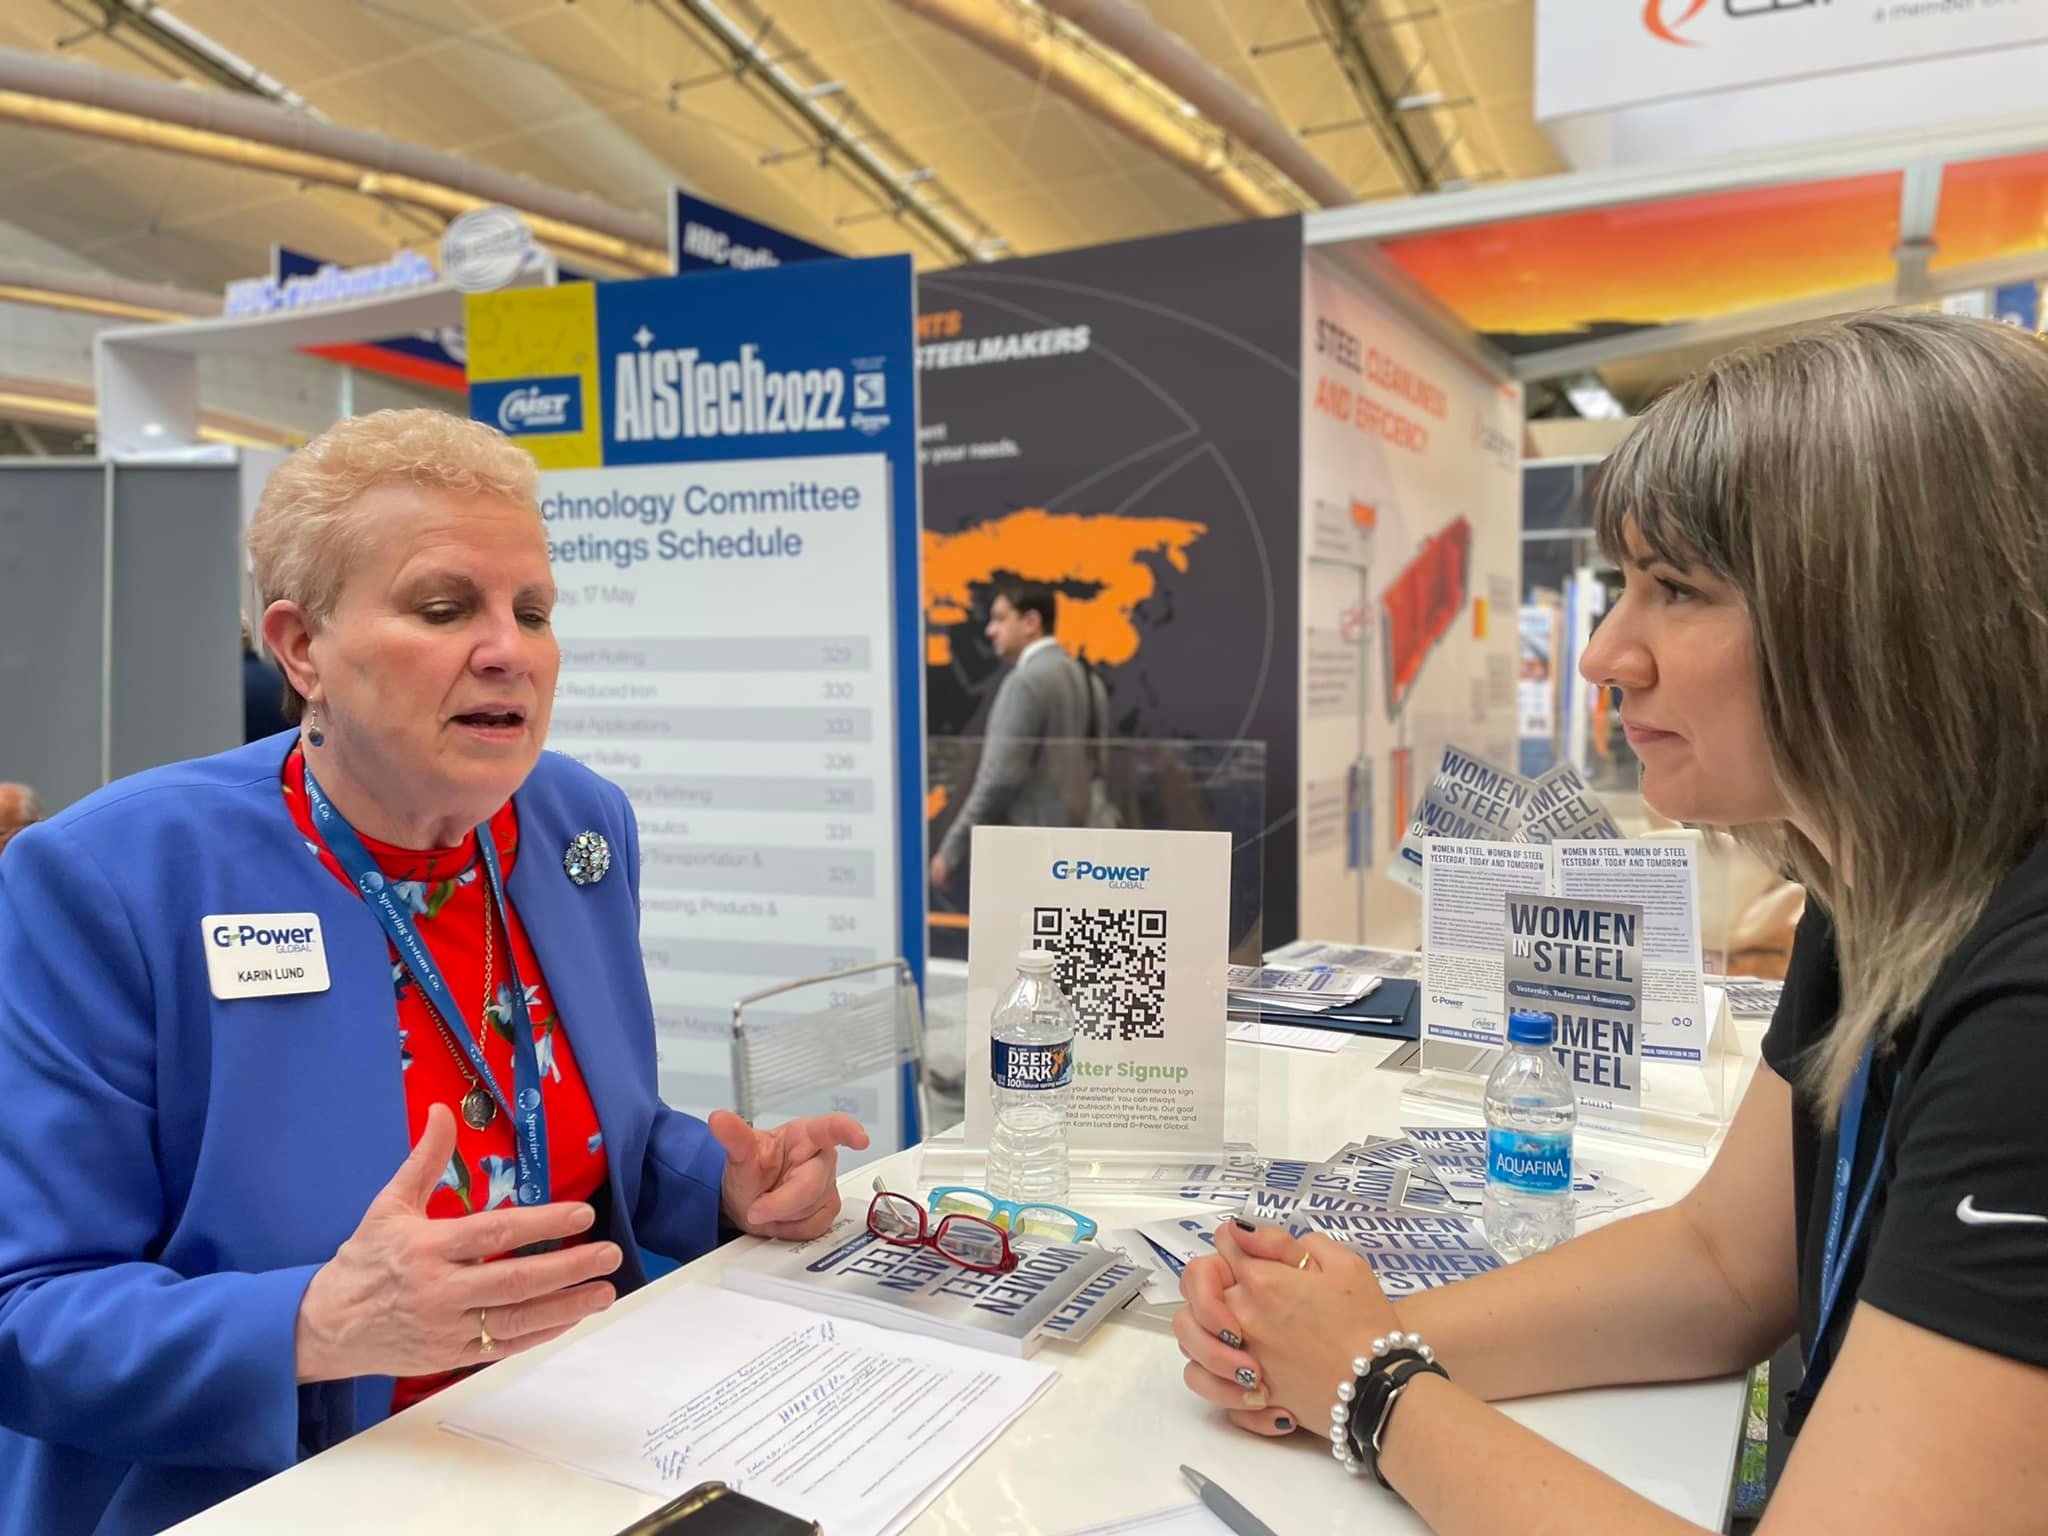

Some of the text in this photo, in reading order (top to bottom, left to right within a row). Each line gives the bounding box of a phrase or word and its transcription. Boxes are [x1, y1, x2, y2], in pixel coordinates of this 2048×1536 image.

[541, 481, 862, 525] chnology Committee
[548, 527, 804, 569] eetings Schedule
[1441, 751, 1530, 809] WOMEN
[1522, 770, 1585, 823] MEN
[1445, 782, 1510, 832] STEEL
[1487, 848, 1512, 858] WOMEN
[1523, 851, 1543, 860] STEEL
[1561, 847, 1588, 857] WOMEN
[1624, 848, 1651, 857] WOMEN
[1664, 848, 1687, 857] STEEL
[1052, 860, 1151, 882] G-Power
[1507, 860, 1545, 870] TOMORROW
[1647, 859, 1688, 868] TOMORROW
[1108, 880, 1145, 890] GLOBAL
[1510, 903, 1636, 947] WOMEN
[213, 924, 314, 948] G-Power
[377, 891, 441, 992] Spraying Systems Co.
[1512, 938, 1531, 959] IN
[1534, 941, 1634, 983] STEEL
[237, 966, 305, 983] KARIN LUND
[1553, 989, 1575, 1001] Today
[1577, 992, 1591, 1001] and
[1510, 1007, 1633, 1056] OMEN
[1008, 1050, 1052, 1066] DEER
[1008, 1065, 1053, 1082] PARK
[1117, 1061, 1189, 1083] Signup
[1552, 1046, 1631, 1091] TEEL
[1090, 1086, 1136, 1094] smartphone
[1178, 1087, 1194, 1096] sign
[1118, 1095, 1133, 1103] You
[1149, 1096, 1176, 1105] always
[1091, 1112, 1130, 1121] upcoming
[1177, 1105, 1195, 1114] goal
[1073, 1120, 1093, 1128] Karin
[1116, 1121, 1128, 1129] and
[1409, 1129, 1487, 1142] WOM
[1496, 1152, 1566, 1178] AQUAFINA
[1310, 1214, 1469, 1234] WOMEN
[1354, 1232, 1485, 1251] STEEL
[973, 1247, 1089, 1317] WOMEN
[1382, 1270, 1481, 1291] STE
[1044, 1263, 1137, 1332] WOMEN
